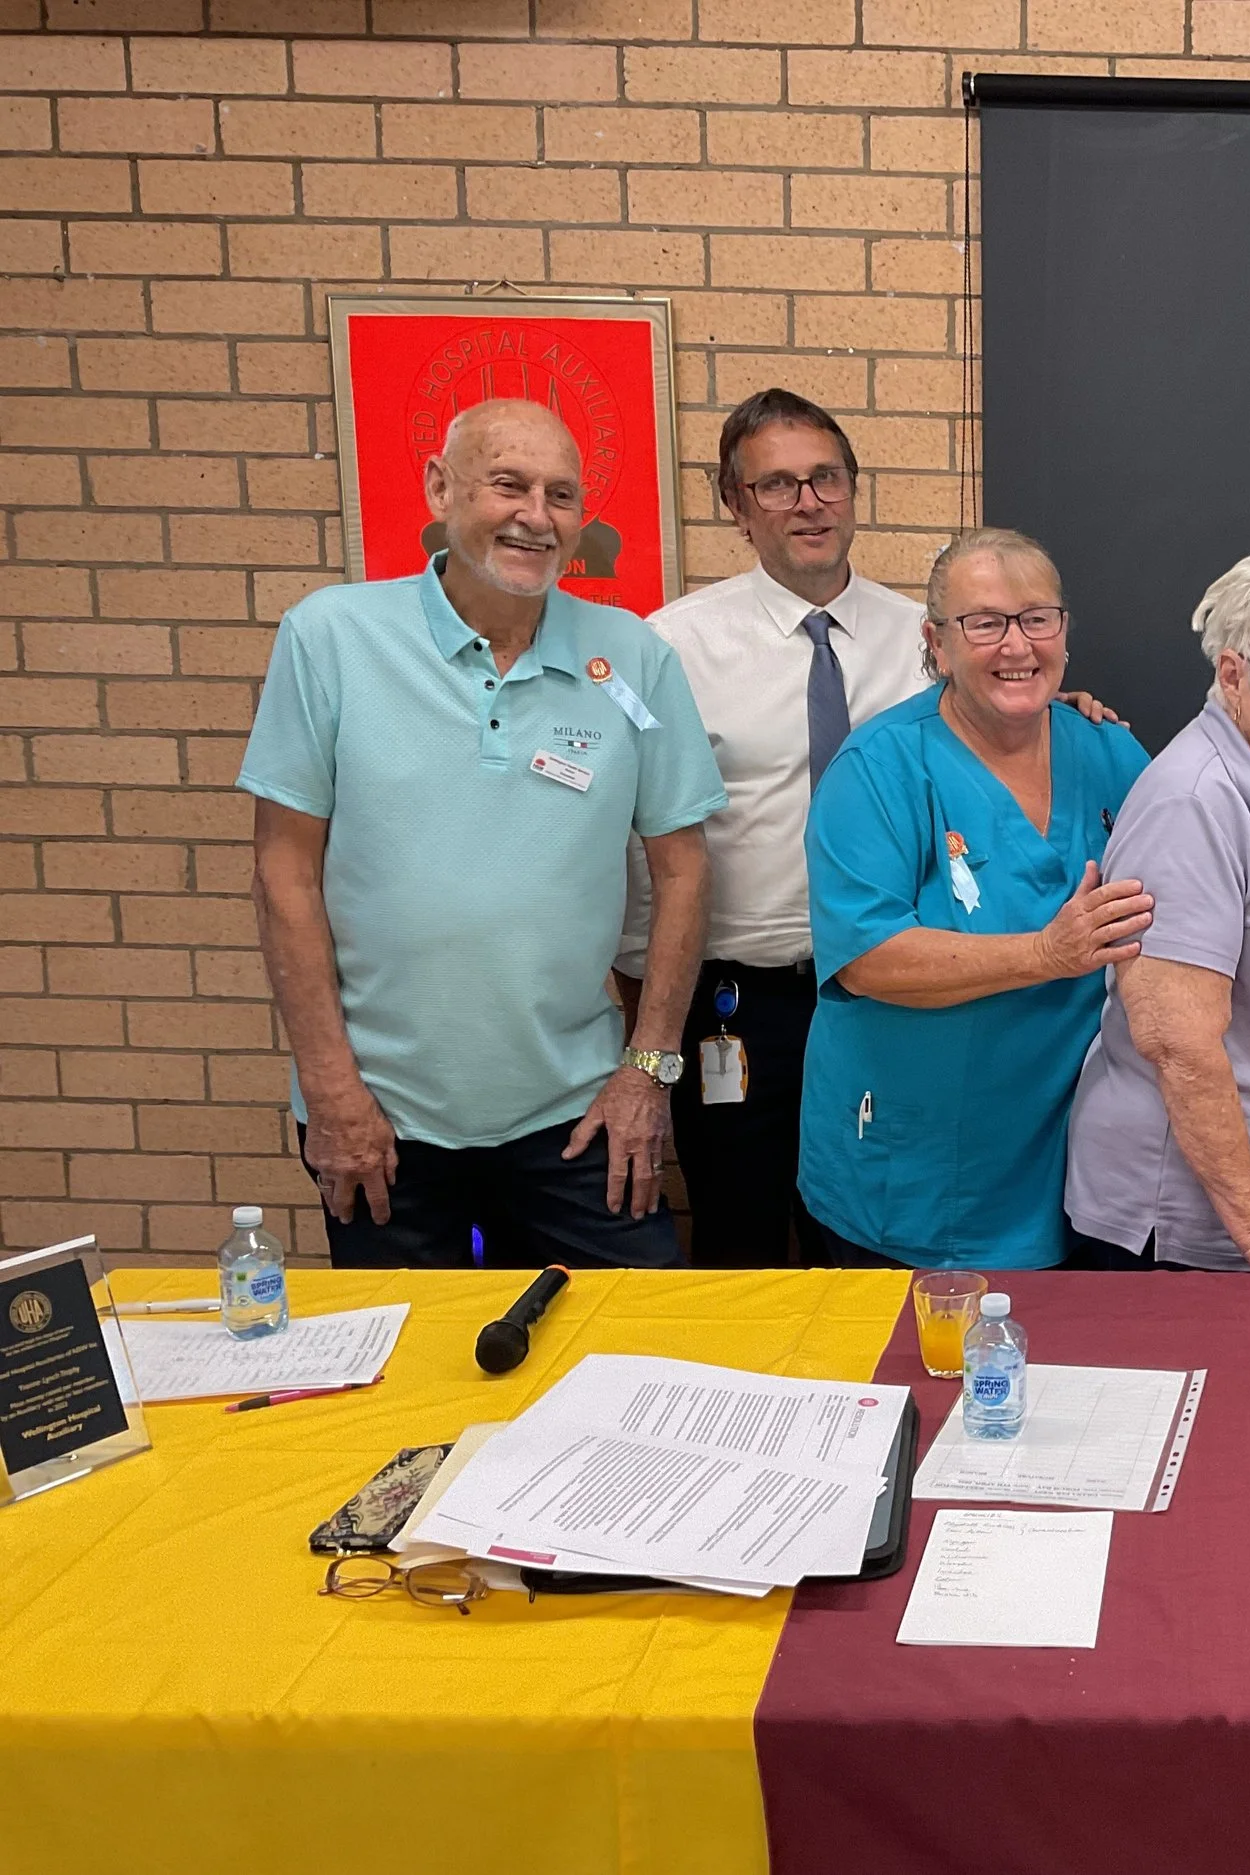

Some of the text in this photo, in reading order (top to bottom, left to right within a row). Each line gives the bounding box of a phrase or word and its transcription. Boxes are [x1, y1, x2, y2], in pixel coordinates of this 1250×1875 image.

[419, 330, 528, 402] HOSPITAL
[412, 411, 439, 460] TED
[553, 726, 602, 741] MILANO
[18, 1299, 45, 1325] UHA
[974, 1380, 1009, 1388] SPRING
[975, 1387, 1007, 1395] WATER
